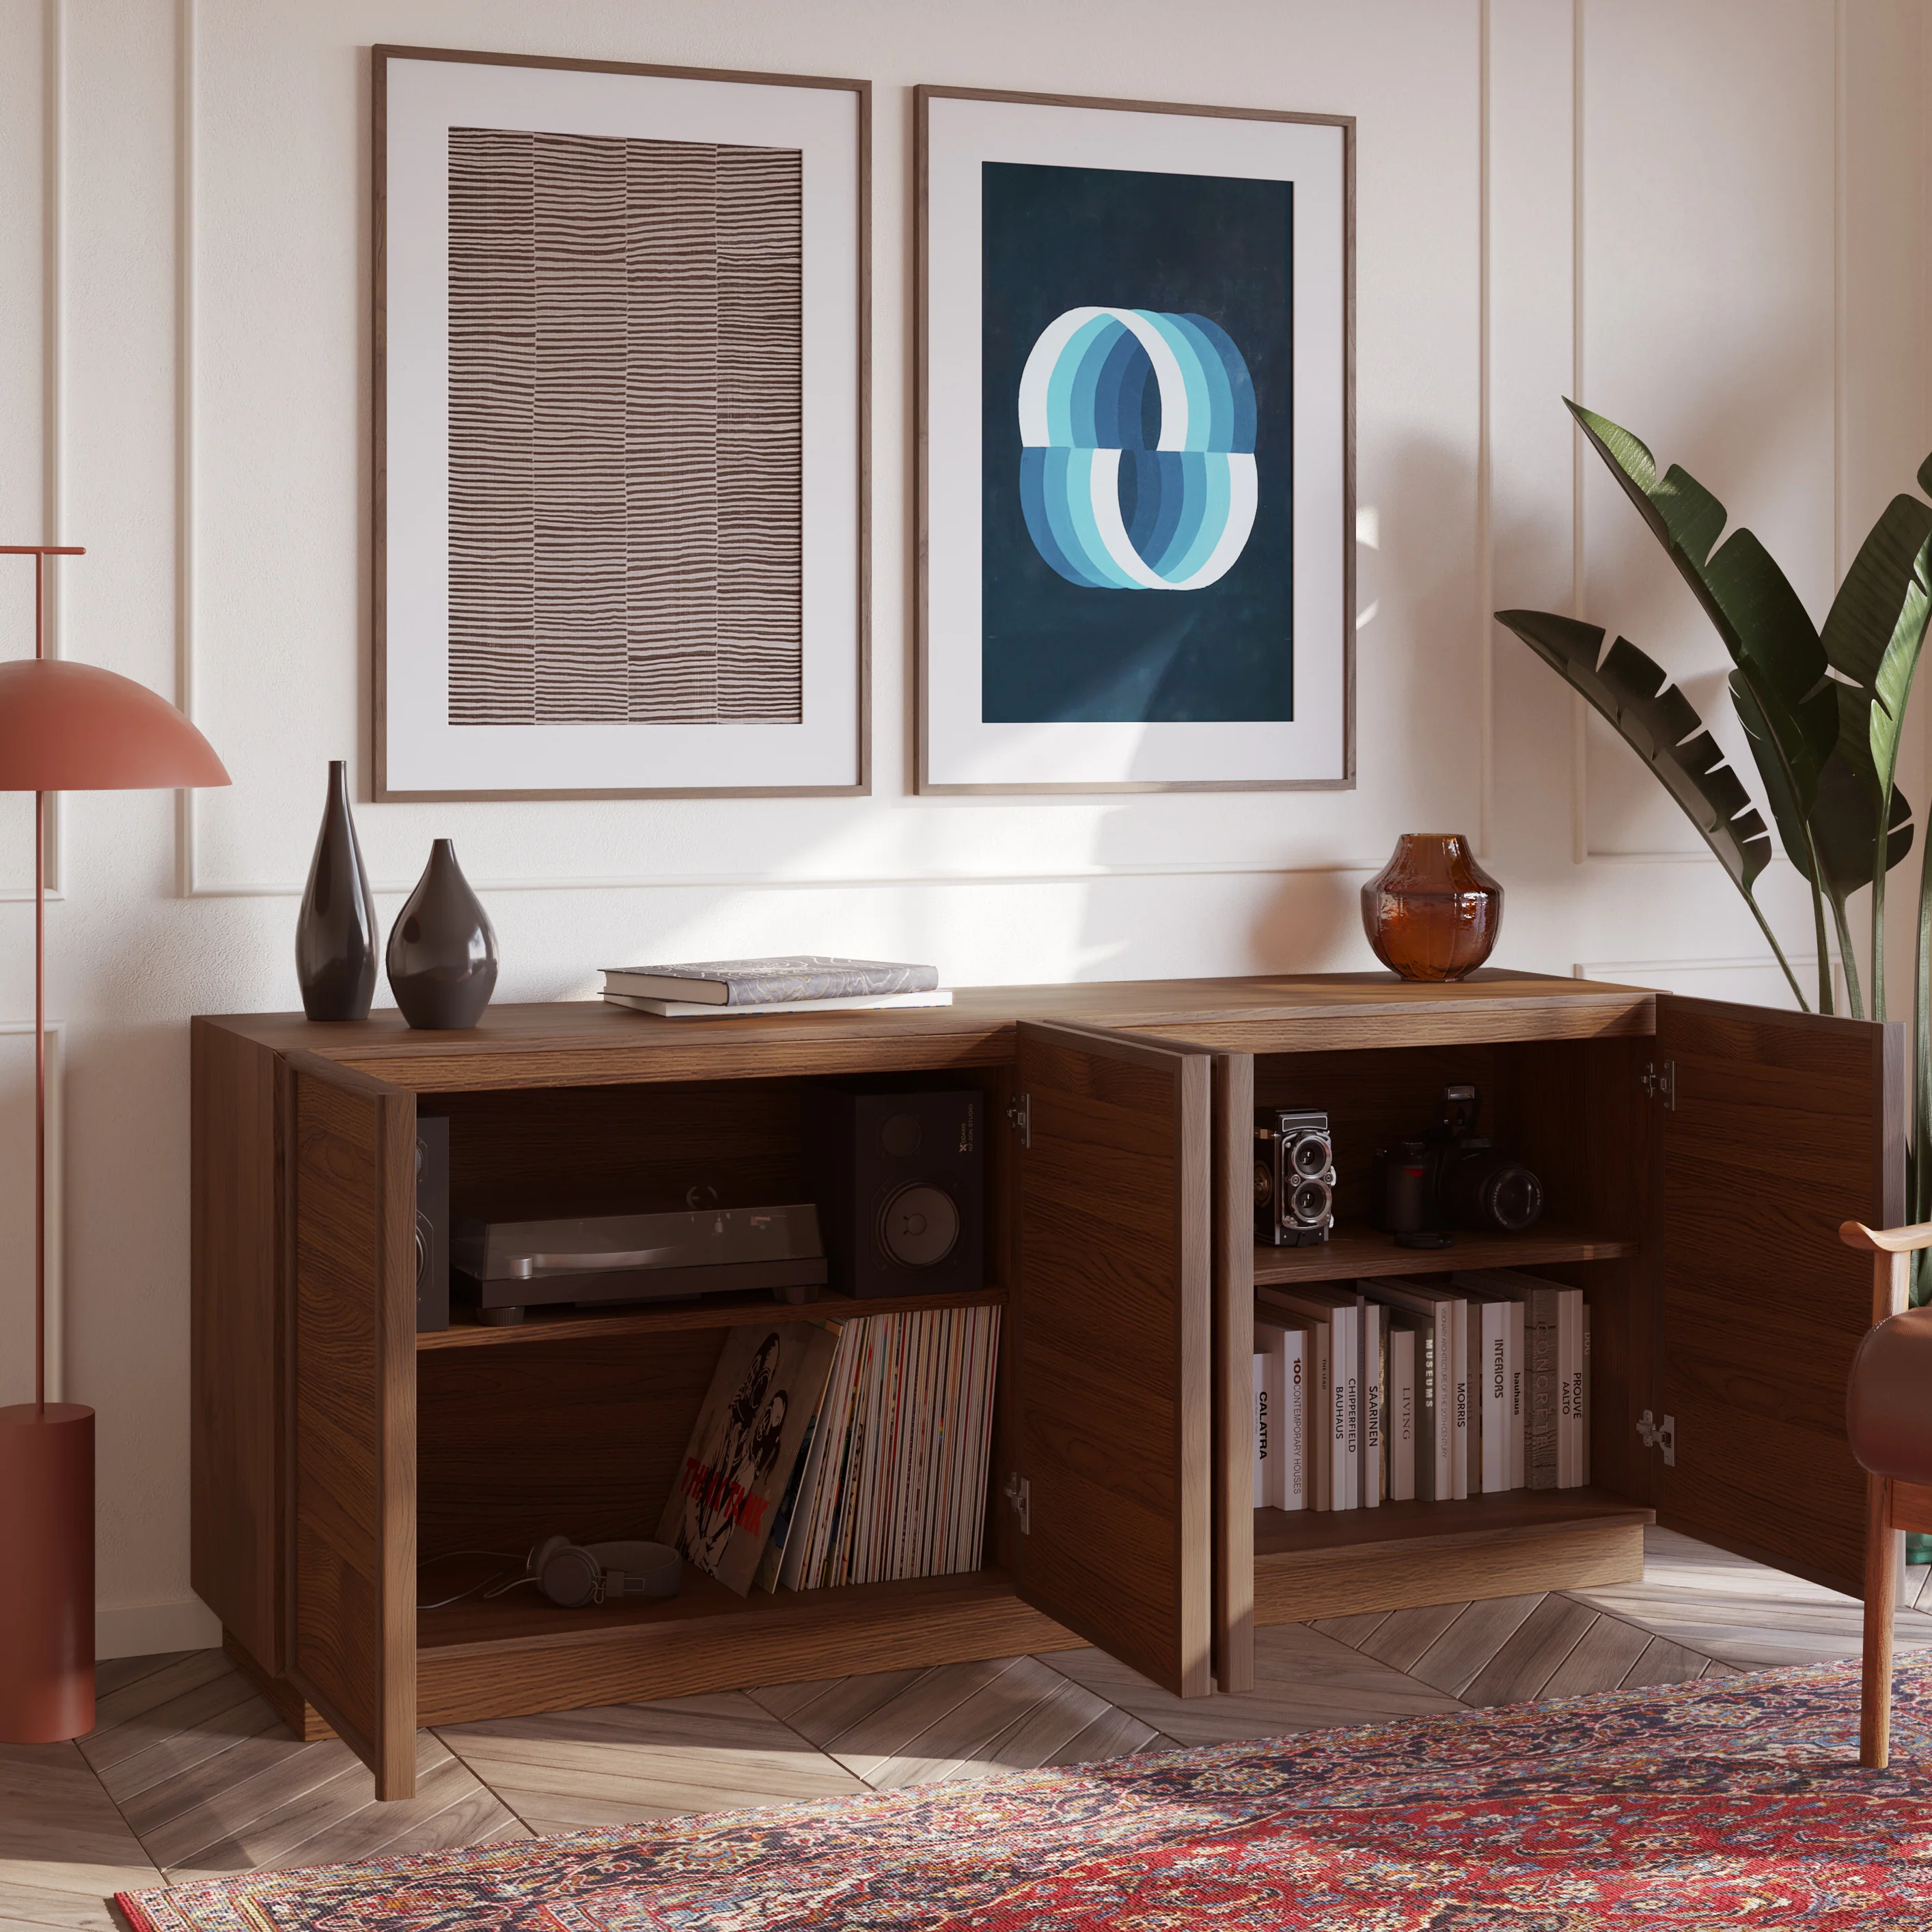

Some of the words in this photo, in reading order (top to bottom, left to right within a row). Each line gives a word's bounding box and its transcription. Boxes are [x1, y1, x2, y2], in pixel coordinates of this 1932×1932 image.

[1425, 1339, 1433, 1407] MUSEUMS
[1494, 1339, 1504, 1398] INTERIORS
[1535, 1323, 1549, 1448] CONCRETE
[1573, 1372, 1584, 1419] PROUVÉ
[1259, 1391, 1268, 1461] CALATRA
[1336, 1386, 1344, 1439] BAUHAUS
[1348, 1378, 1356, 1452] CHIPPERFIELD
[1369, 1385, 1378, 1447] SAARINEN
[1403, 1387, 1411, 1441] LIVING
[1457, 1383, 1465, 1428] MORRIS
[1293, 1459, 1301, 1494] HOUSES
[723, 1480, 770, 1537] TANK
